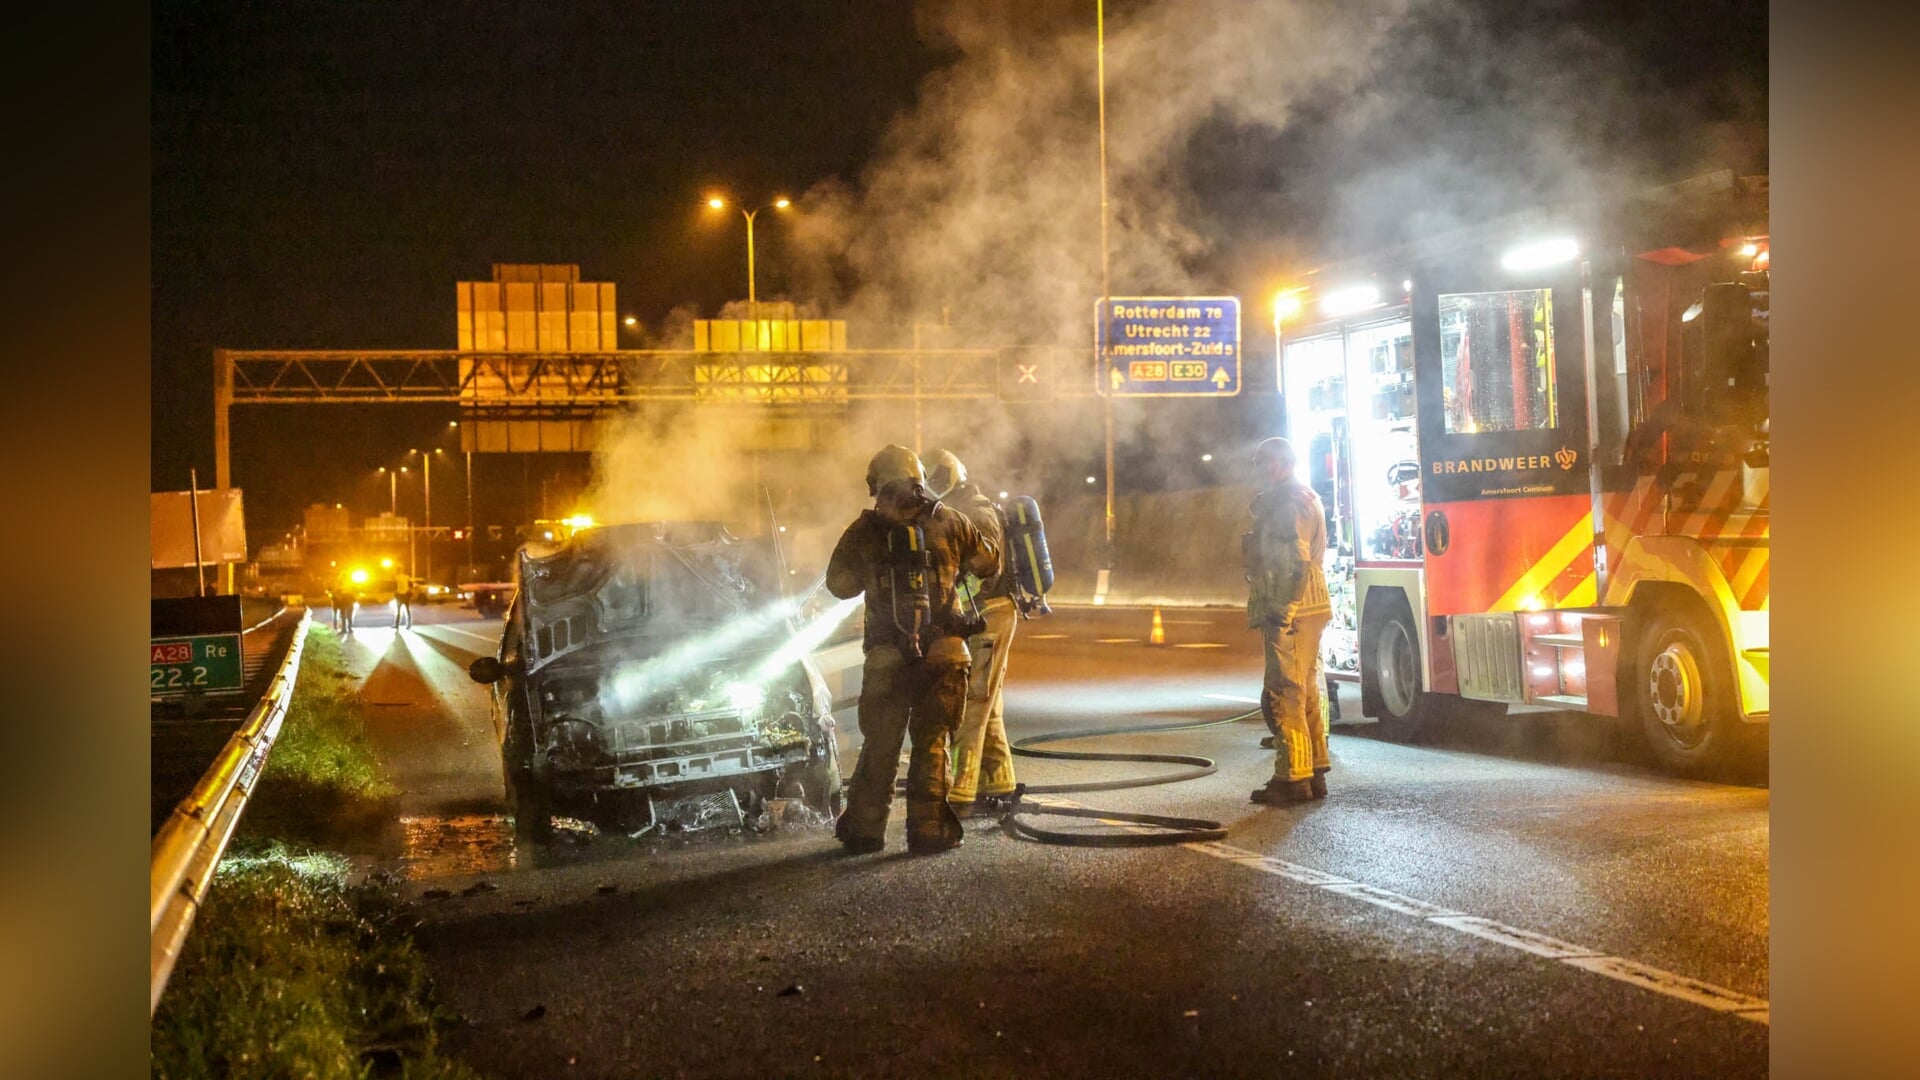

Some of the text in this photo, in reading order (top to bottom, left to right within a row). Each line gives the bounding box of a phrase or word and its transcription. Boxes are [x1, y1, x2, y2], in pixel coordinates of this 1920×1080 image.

[1113, 305, 1201, 319] Rotterdam
[1125, 324, 1212, 338] Utrecht 22
[1173, 365, 1203, 377] E30
[1432, 455, 1551, 475] BRANDWEER
[1480, 487, 1522, 496] Amersfoort
[153, 644, 227, 662] A28 Re
[151, 666, 208, 688] 22.2
